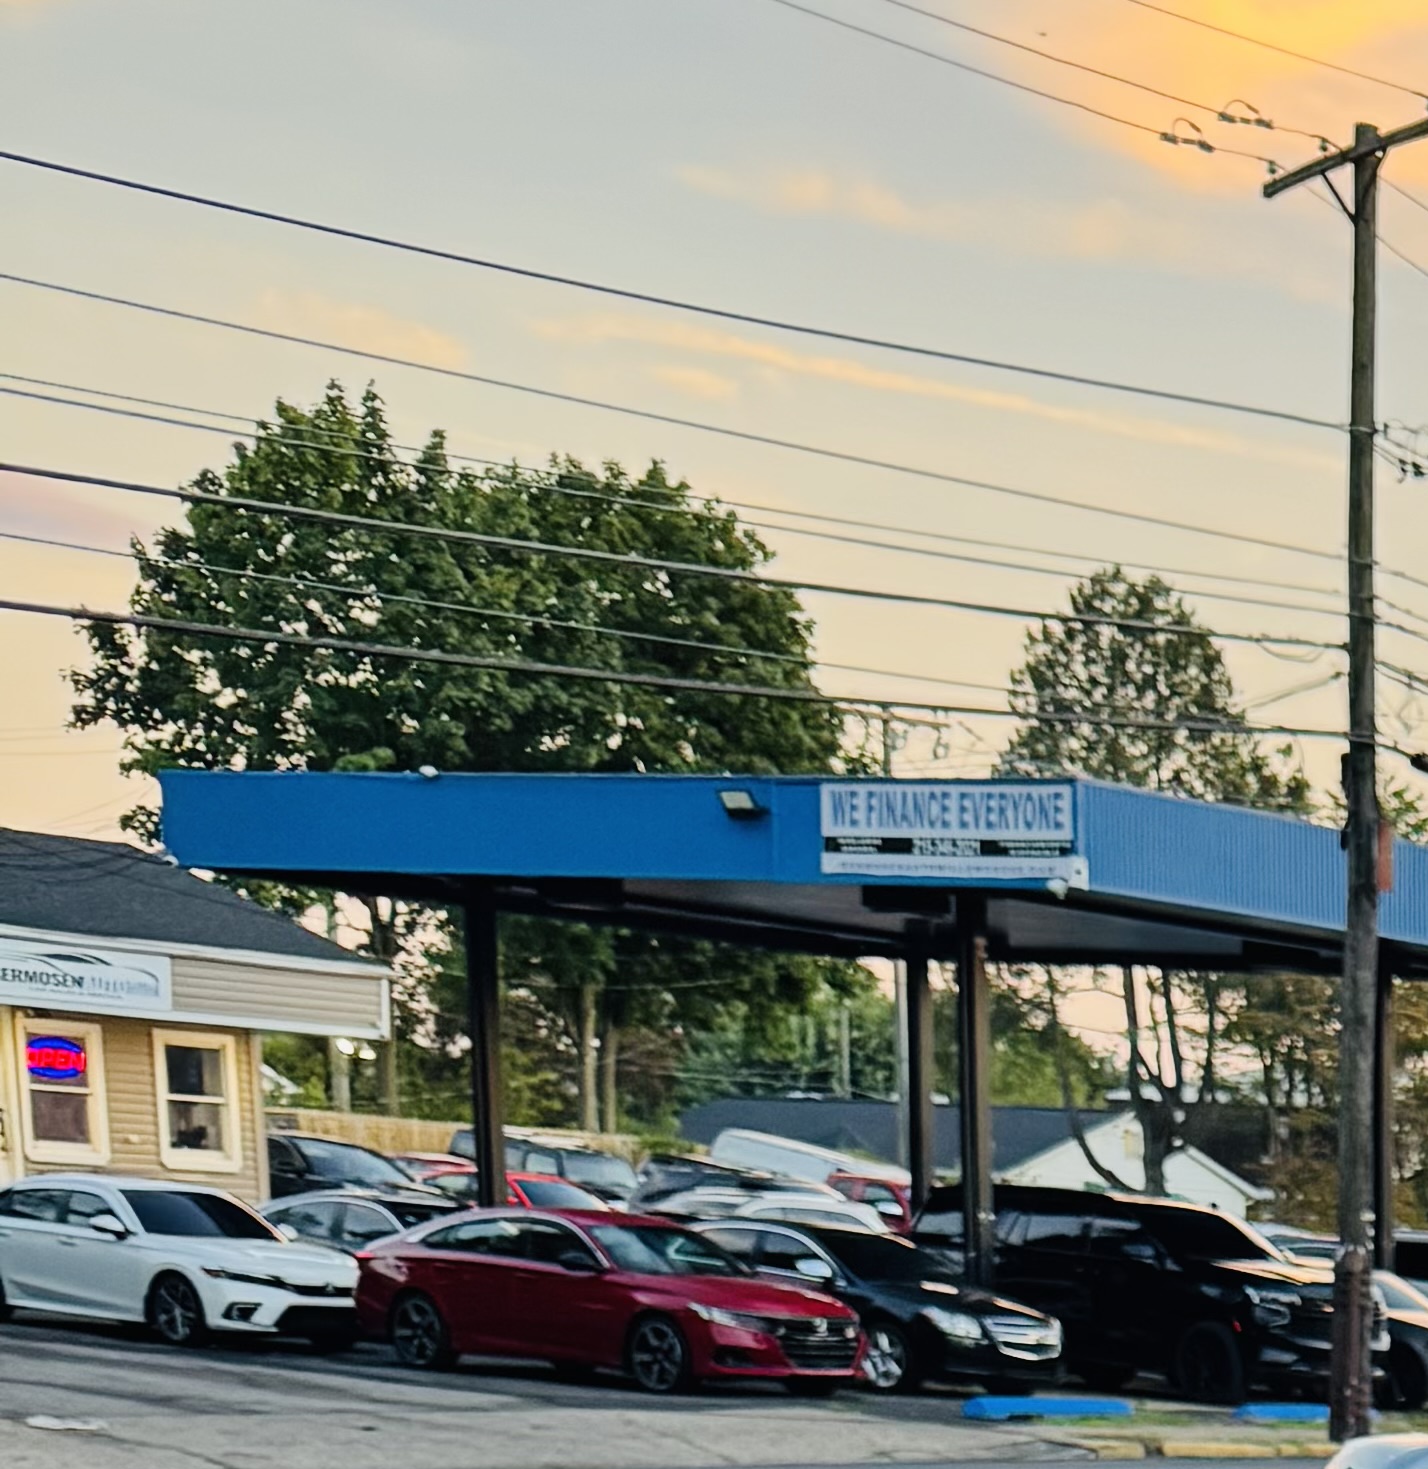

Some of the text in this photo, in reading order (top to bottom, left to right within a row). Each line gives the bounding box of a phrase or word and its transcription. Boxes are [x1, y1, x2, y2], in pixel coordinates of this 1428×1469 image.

[829, 790, 1065, 831] WE FINANCE EVERYONE
[27, 1046, 87, 1073] OPEN
